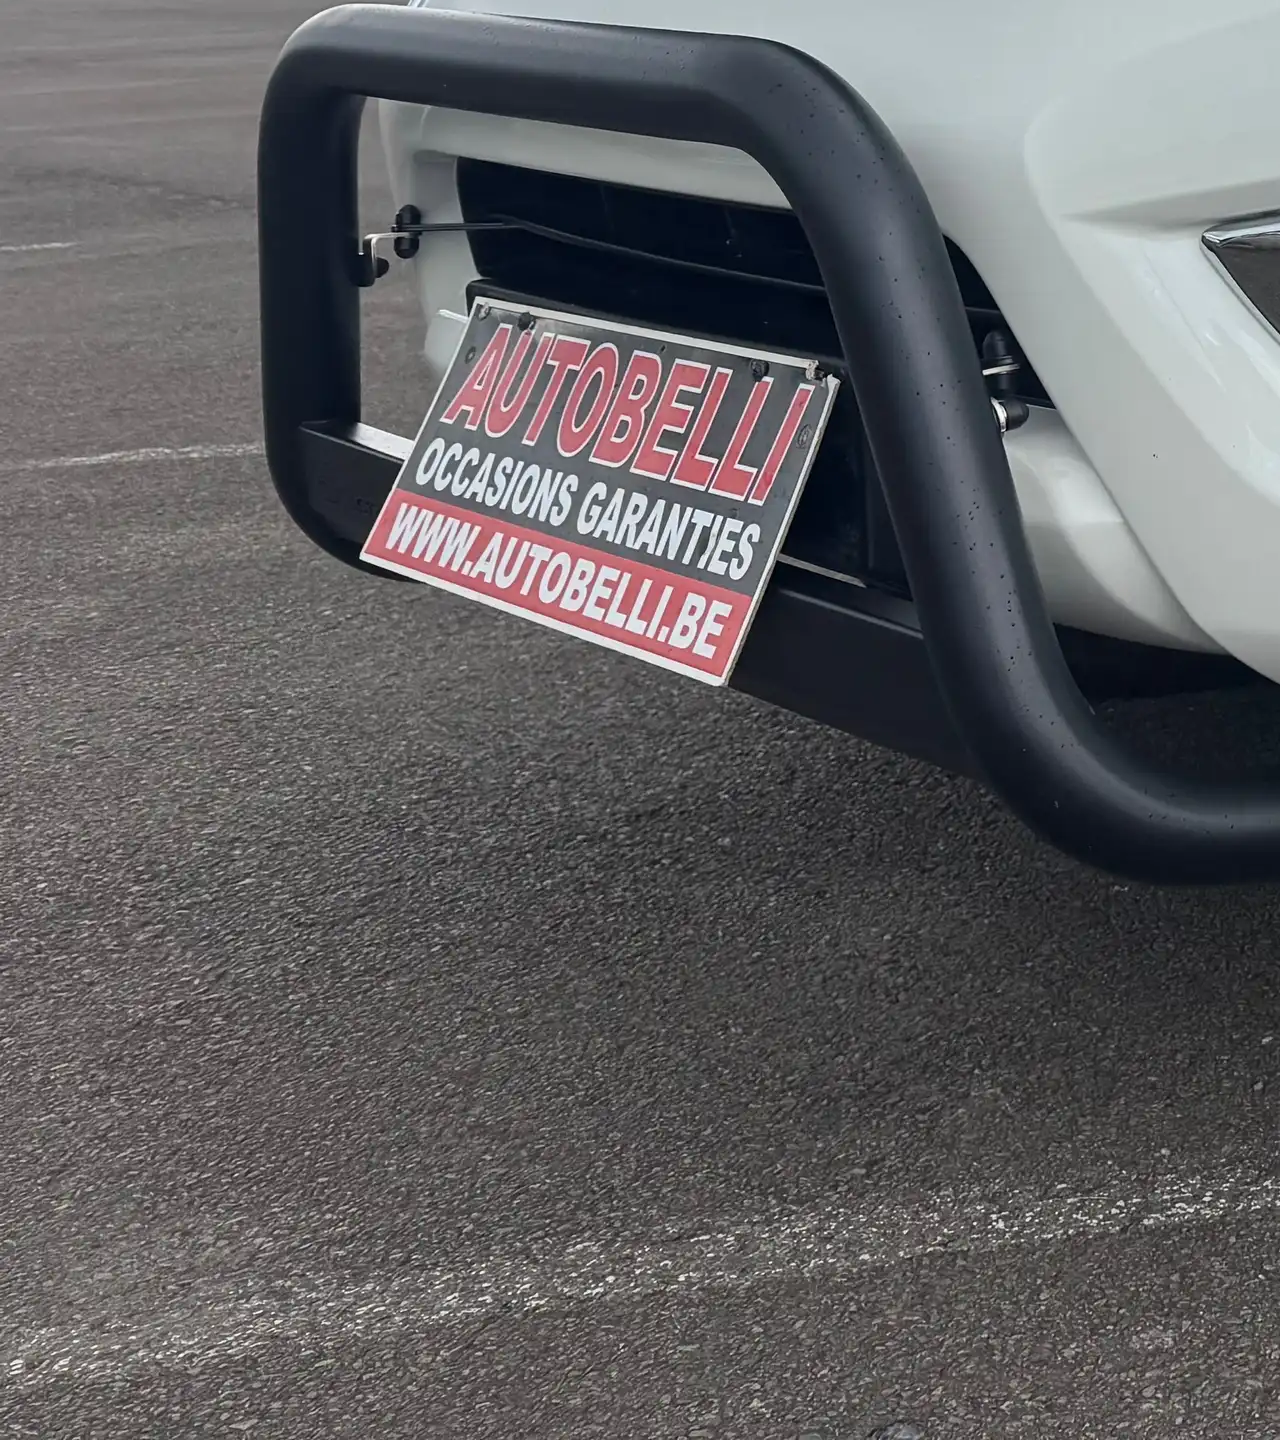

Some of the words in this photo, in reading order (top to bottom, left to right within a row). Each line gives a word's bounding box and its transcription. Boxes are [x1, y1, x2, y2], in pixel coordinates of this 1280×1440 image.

[440, 323, 816, 507] AUTOBELLI
[384, 502, 733, 660] WWW.AUTOBELLI.BE
[414, 437, 579, 527] OCCASIONS
[576, 481, 762, 581] GARANTIES
